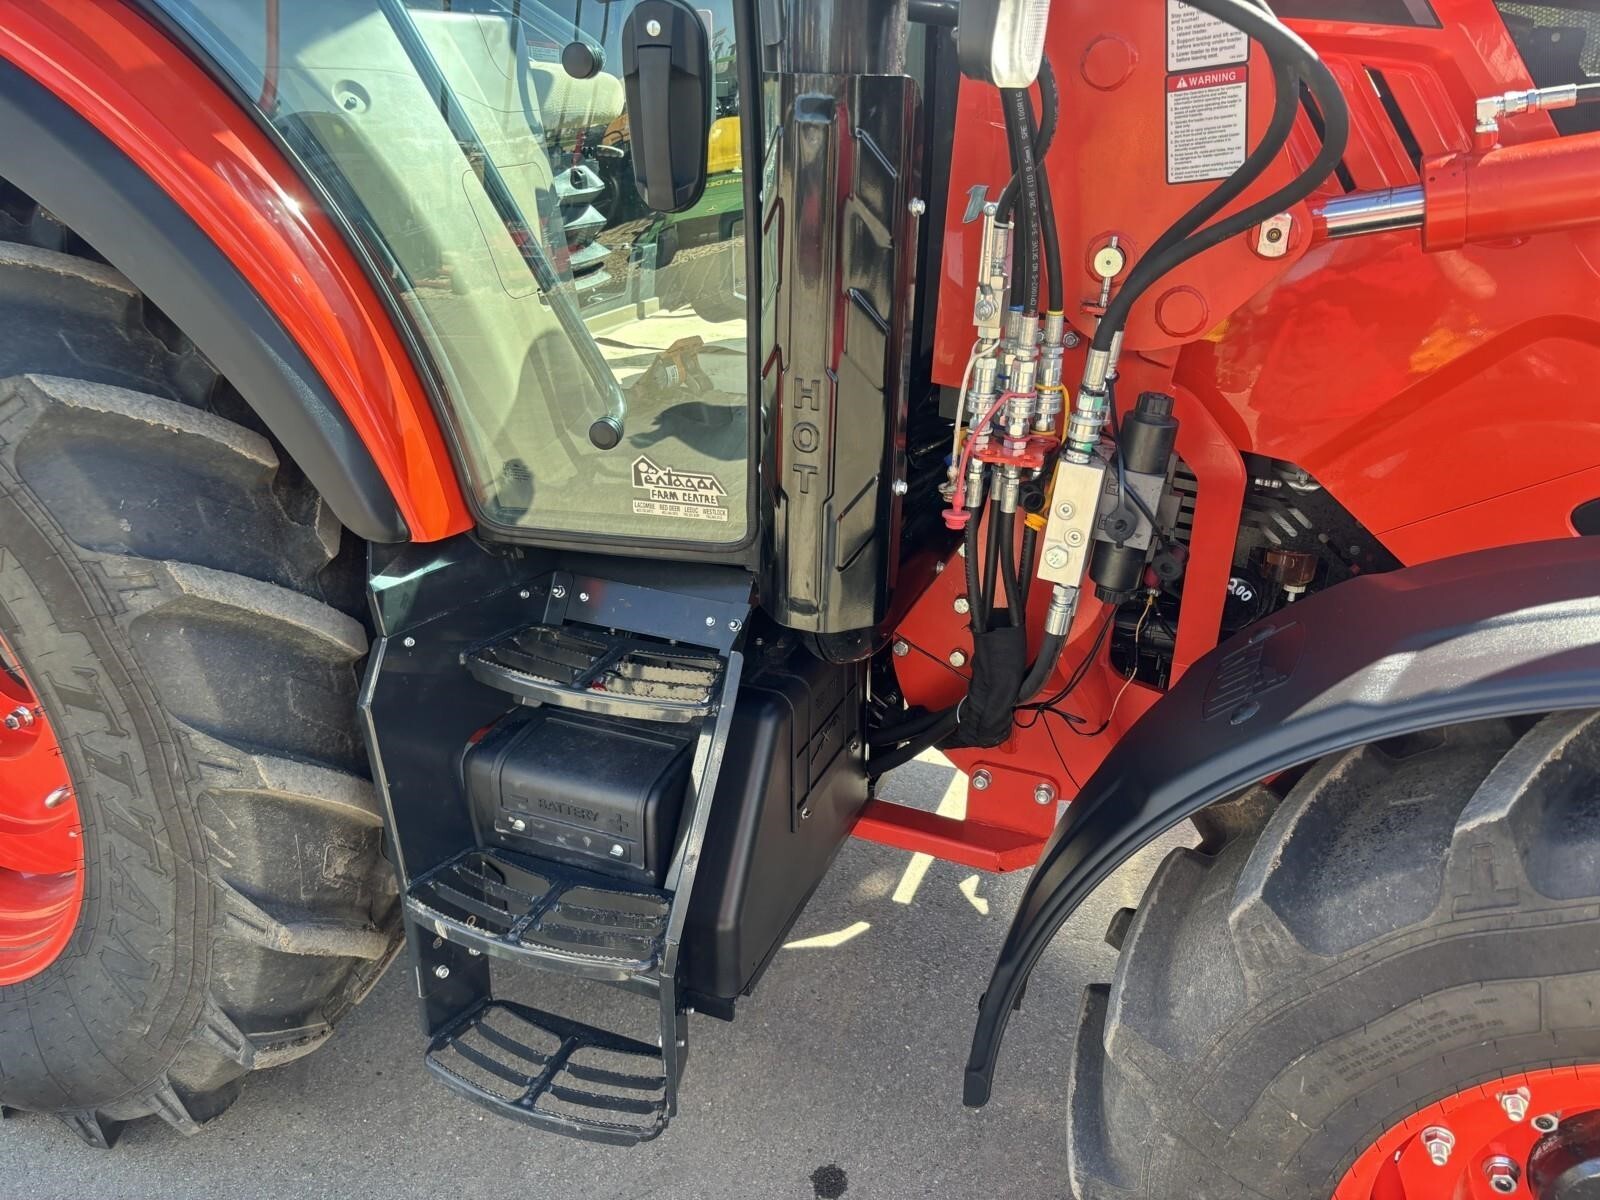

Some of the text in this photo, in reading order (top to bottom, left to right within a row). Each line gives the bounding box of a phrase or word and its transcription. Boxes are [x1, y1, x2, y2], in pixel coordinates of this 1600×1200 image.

[1189, 71, 1236, 87] WARNING
[792, 377, 821, 495] HOT
[651, 489, 717, 505] FARM CENTRE
[702, 508, 726, 517] WESTLOCK
[537, 798, 599, 822] BATTERY
[44, 667, 162, 1010] TITAN
